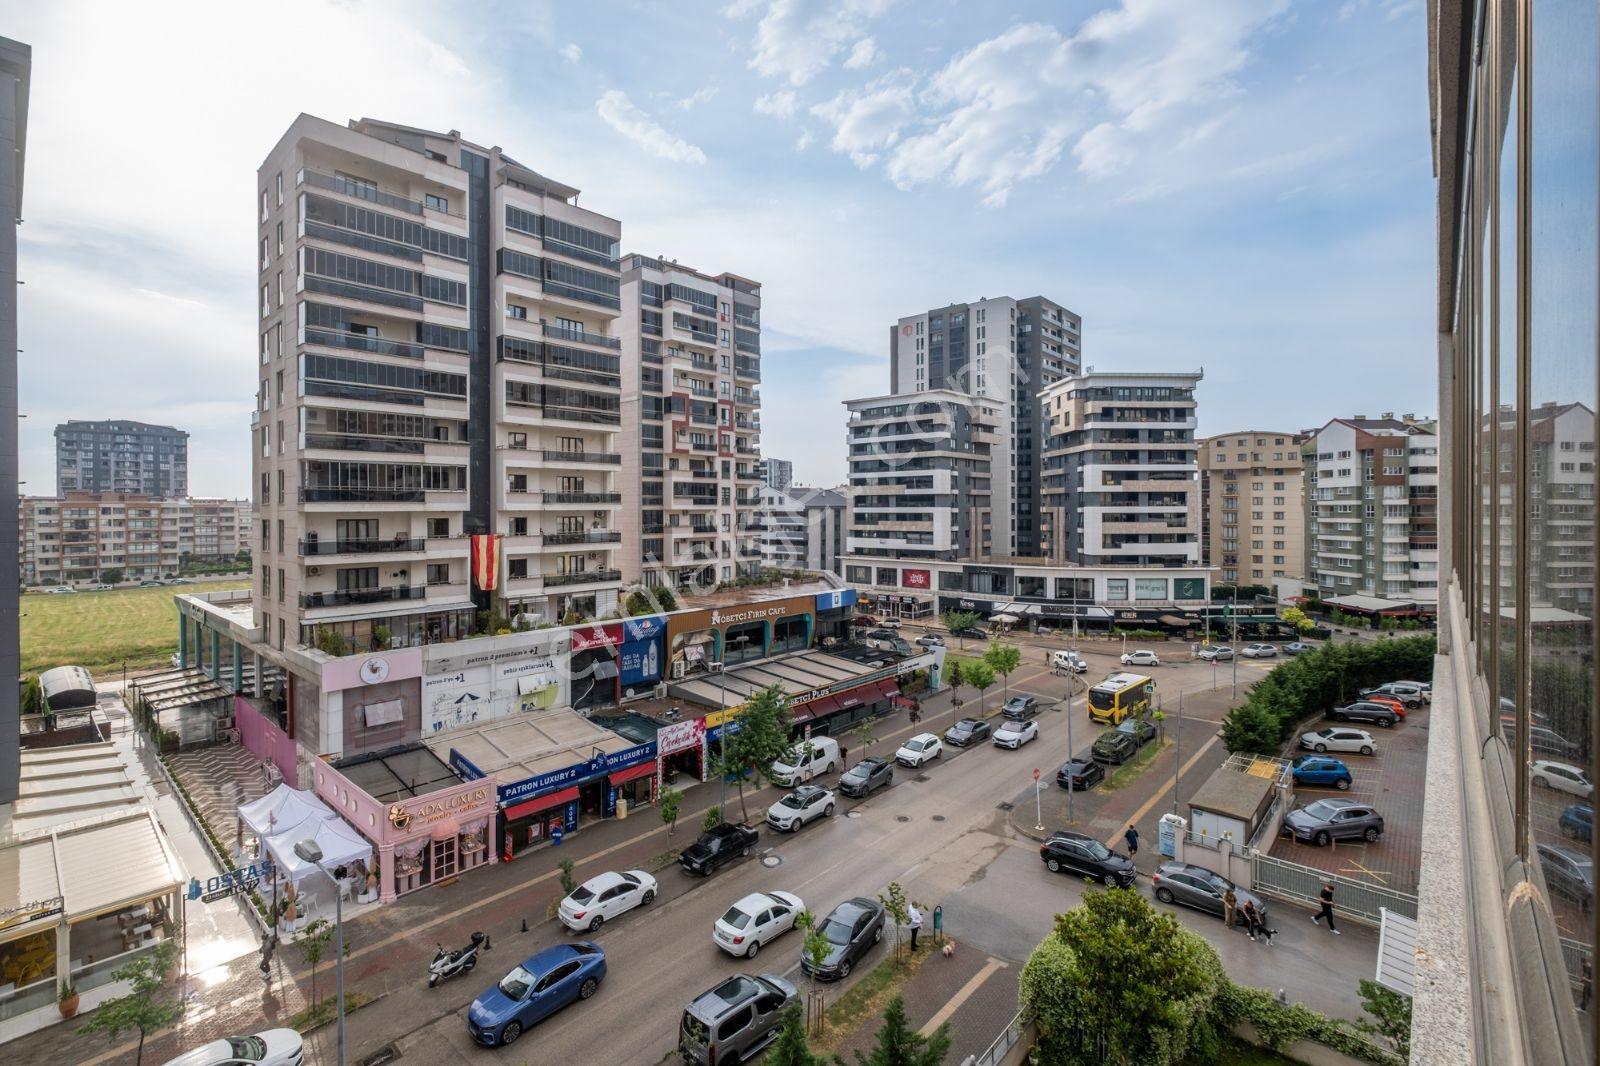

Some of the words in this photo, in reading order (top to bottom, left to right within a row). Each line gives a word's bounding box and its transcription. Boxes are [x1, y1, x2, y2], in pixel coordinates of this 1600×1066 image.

[620, 748, 644, 762] LUXURY
[506, 781, 538, 796] PATRON
[540, 771, 570, 786] LUXURY
[418, 802, 443, 817] ADA
[444, 788, 488, 809] LUXURY
